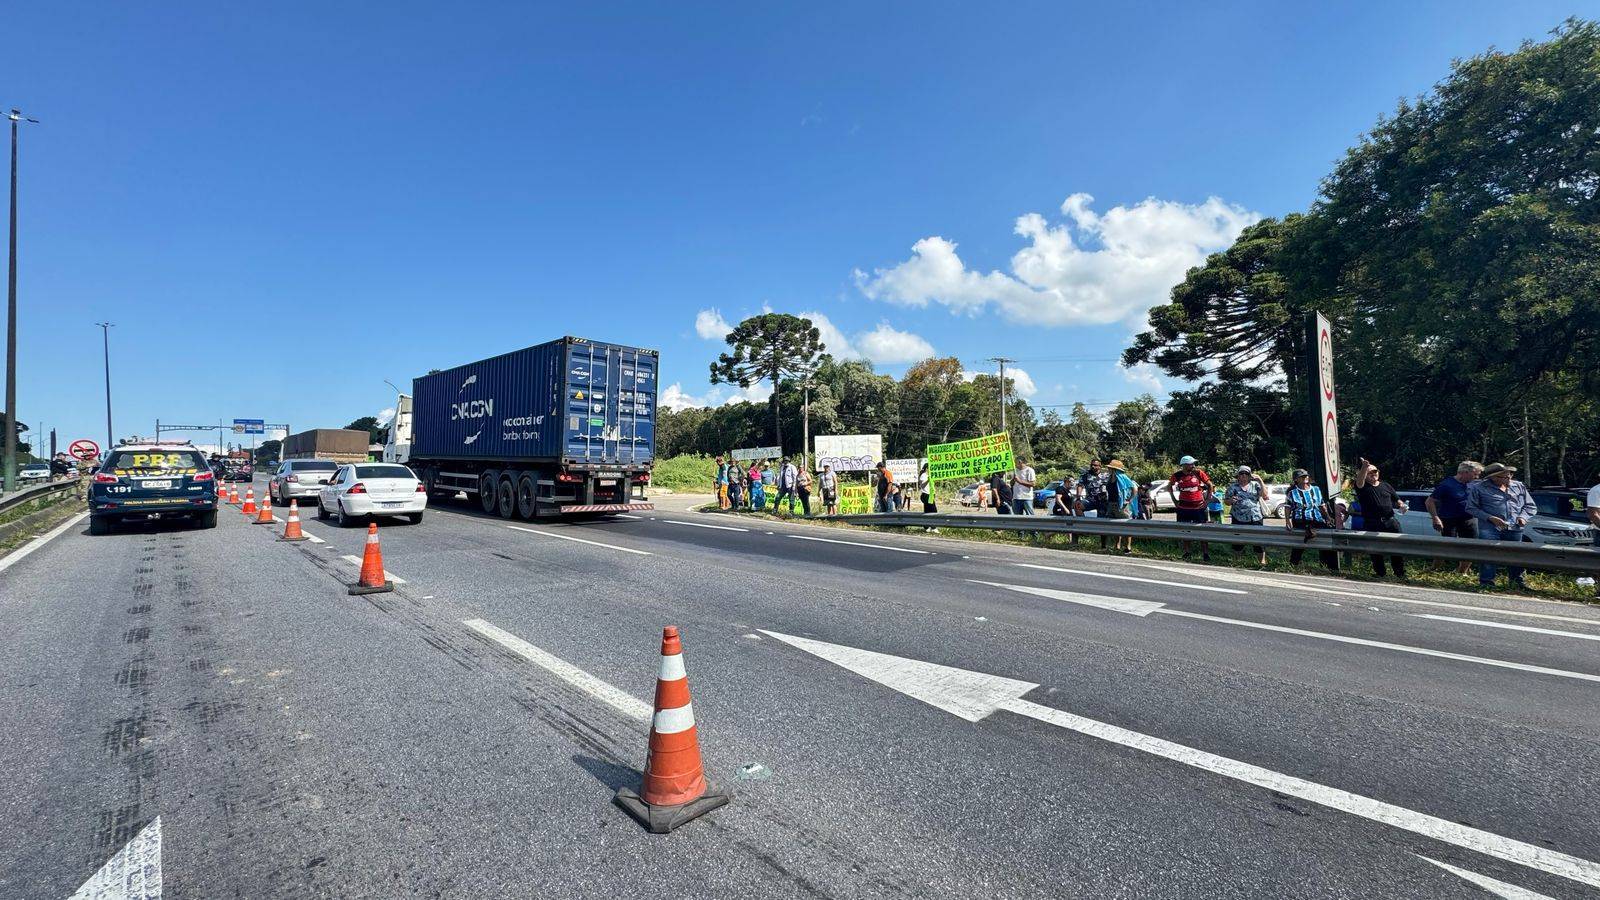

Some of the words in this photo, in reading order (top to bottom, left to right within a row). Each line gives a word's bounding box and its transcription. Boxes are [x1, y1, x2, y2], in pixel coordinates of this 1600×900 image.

[961, 441, 978, 450] ALTO
[993, 443, 1010, 452] PELO
[133, 454, 181, 467] PRF
[930, 462, 957, 471] GOVERNO
[973, 455, 1002, 467] ESTADO
[931, 468, 970, 479] PREFEITURA
